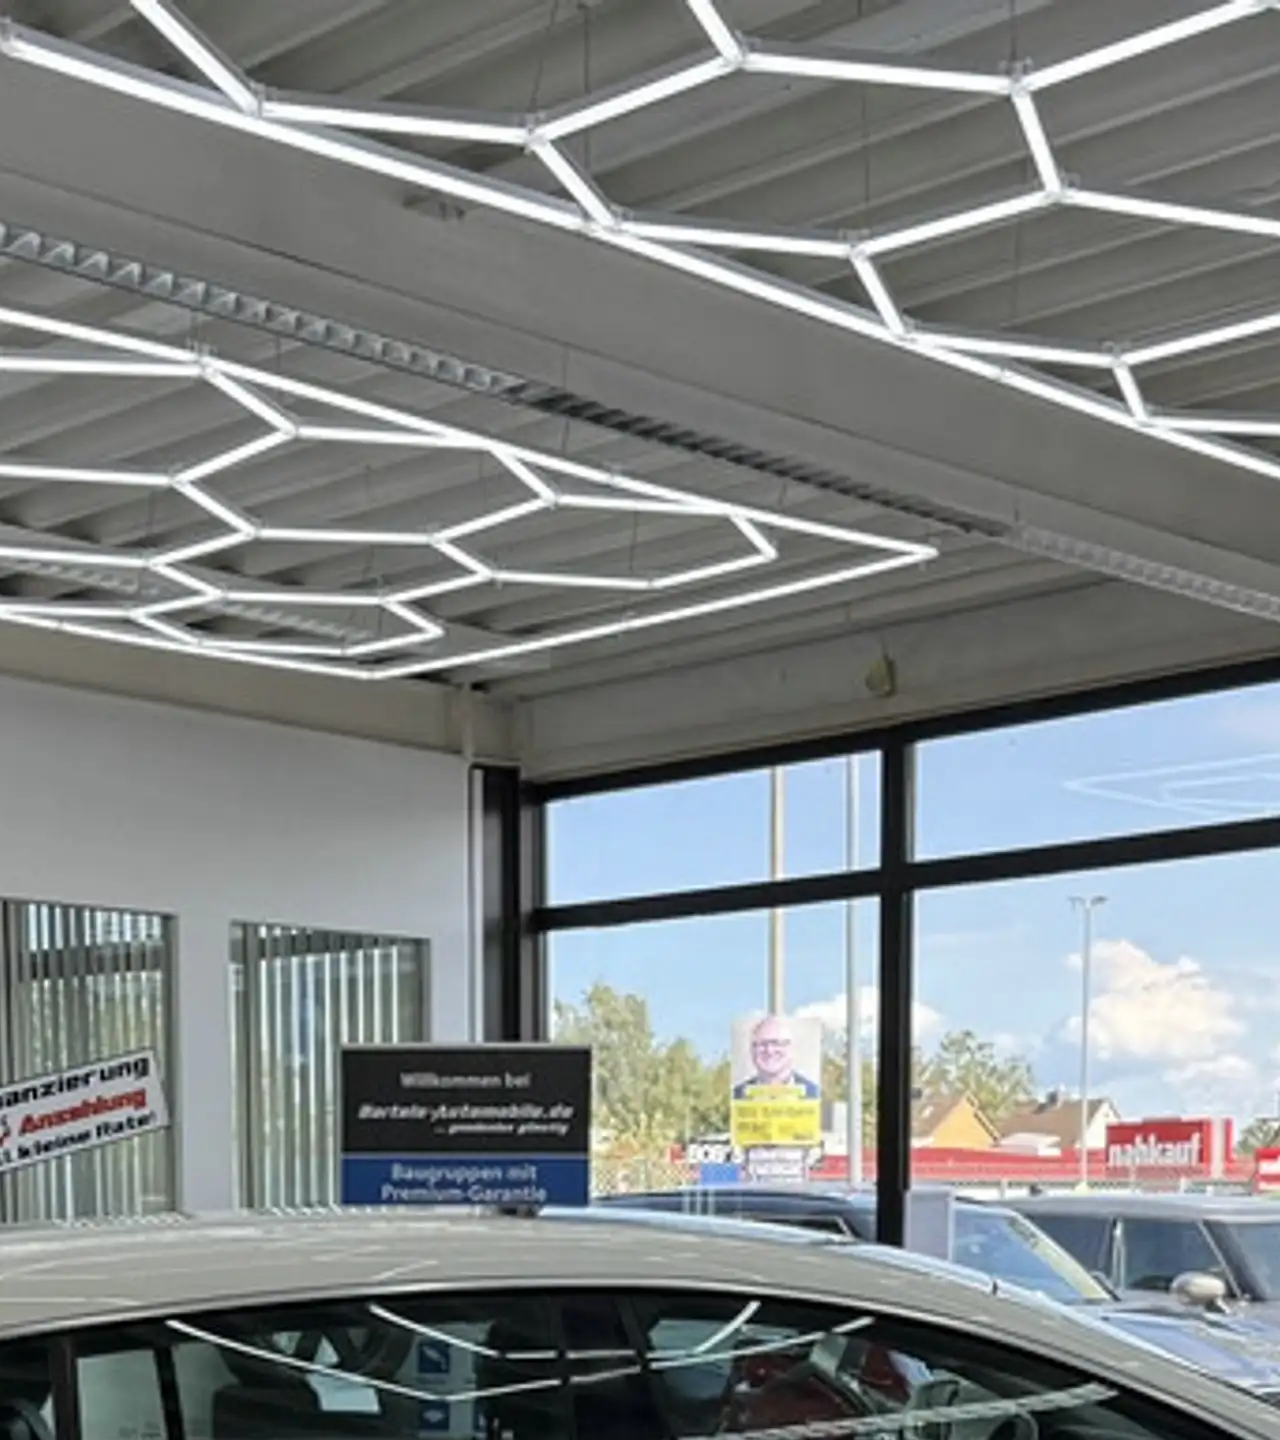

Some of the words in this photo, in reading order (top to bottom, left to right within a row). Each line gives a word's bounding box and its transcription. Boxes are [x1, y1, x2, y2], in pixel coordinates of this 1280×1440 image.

[400, 1073, 501, 1088] Willkommen
[19, 1089, 146, 1136] Anzahlung
[1109, 1132, 1200, 1166] nahkauf
